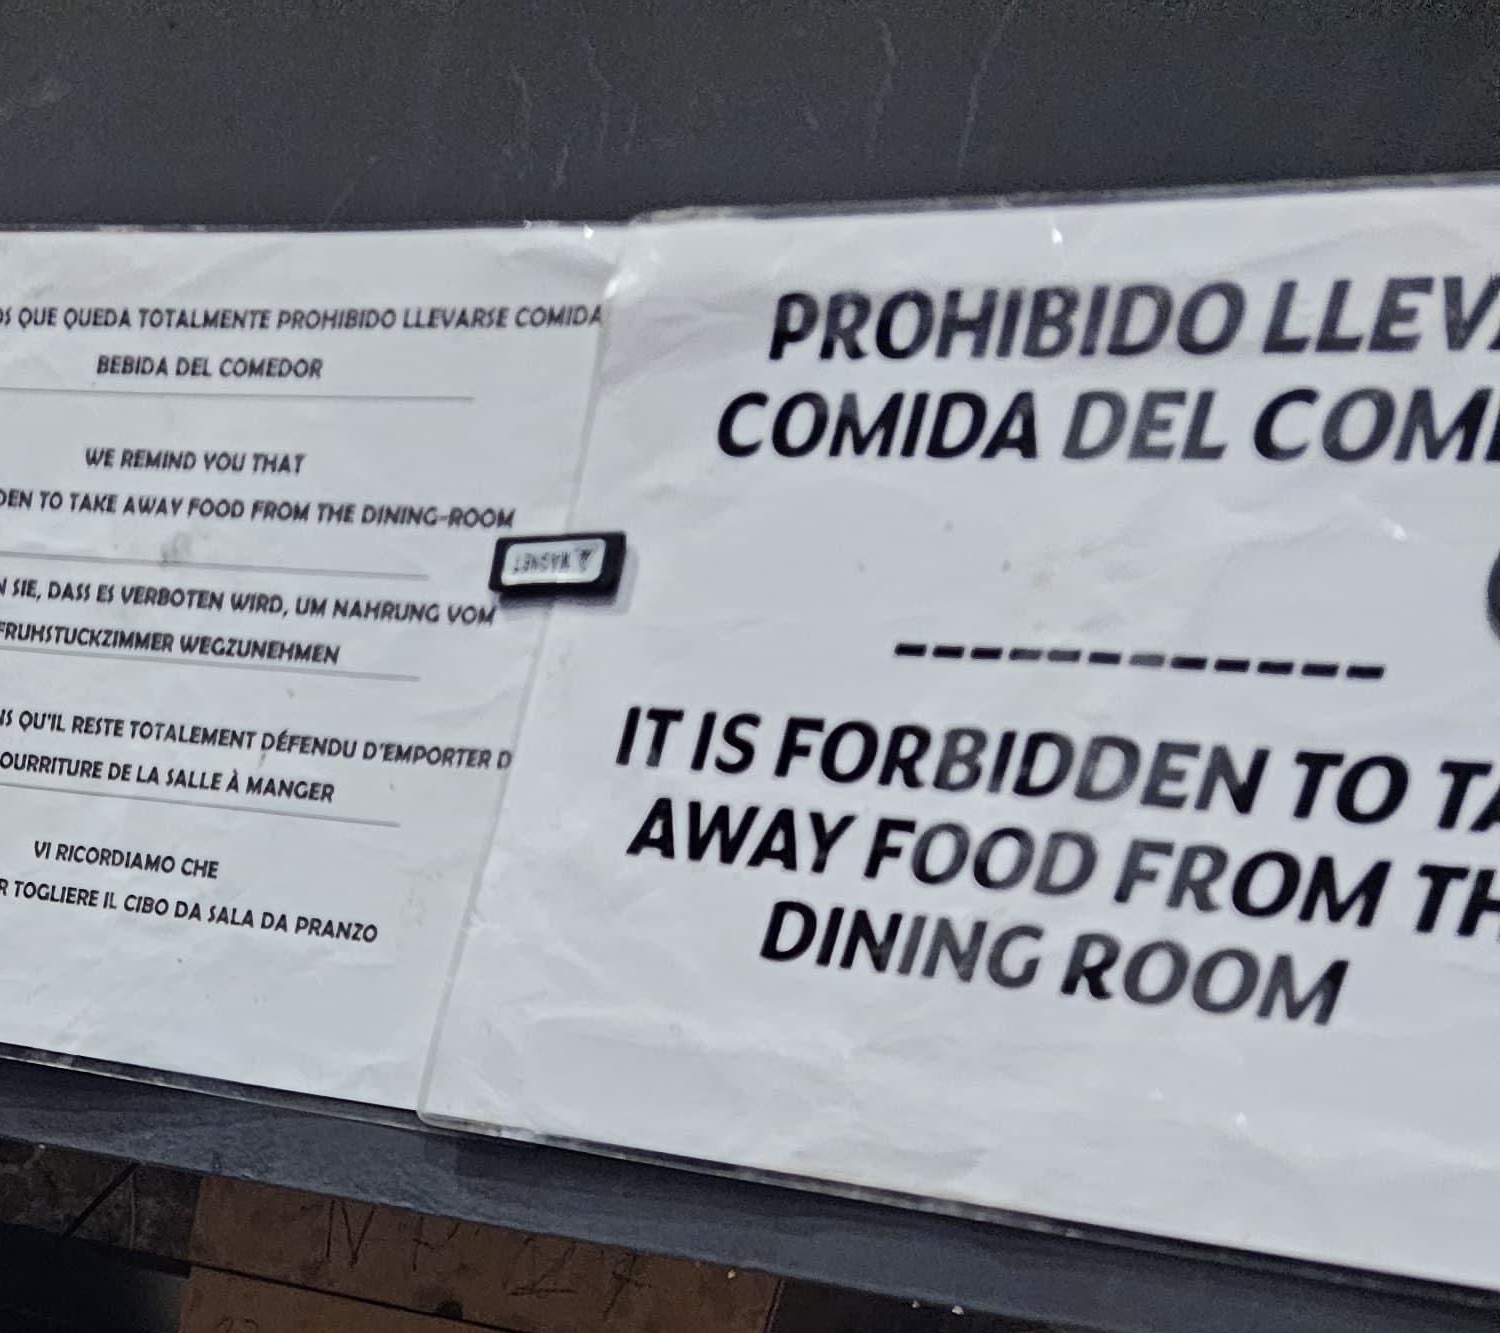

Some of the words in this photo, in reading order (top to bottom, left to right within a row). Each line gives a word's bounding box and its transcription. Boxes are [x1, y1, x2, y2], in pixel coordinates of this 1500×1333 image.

[17, 305, 59, 331] QUE
[62, 306, 133, 331] QUEDA
[137, 307, 273, 331] TOTALMENTE
[275, 307, 397, 331] PROHIBIDO
[402, 306, 511, 330] LLEVARSE
[514, 303, 603, 329] COMIDA
[768, 280, 1247, 362] PROHIBIDO
[1261, 273, 1500, 355] LLEV
[95, 354, 169, 377] BEBIDA
[174, 355, 213, 379] DEL
[218, 356, 324, 380] COMEDOR
[717, 390, 1038, 461] COMIDA
[1062, 388, 1228, 461] DEL
[84, 447, 117, 469] WE
[119, 447, 198, 471] REMIND
[203, 450, 248, 473] YOU
[251, 451, 307, 475] THAT
[39, 489, 64, 513] TO
[69, 491, 119, 515] TAKE
[121, 495, 185, 518] AWAY
[186, 496, 246, 520] FOOD
[249, 499, 312, 523] FROM
[316, 501, 357, 525] THE
[360, 503, 517, 530] DINING-ROOM
[11, 577, 42, 603] SIE,
[47, 579, 92, 604] DASS
[95, 583, 116, 605] ES
[120, 584, 226, 613] VERBOTEN
[229, 591, 289, 620] WIRD,
[294, 595, 329, 618] UM
[331, 597, 441, 625] NAHRUNG
[446, 604, 497, 627] VOM
[179, 633, 341, 666] WEGZUNEHMEN
[18, 709, 67, 734] QU'IL
[70, 714, 126, 739] RESTE
[129, 719, 258, 751] TOTALEMENT
[259, 728, 359, 762] DÉFENDU
[361, 740, 493, 770] D'EMPORTER
[107, 761, 133, 783] DE
[135, 764, 160, 787] LA
[164, 767, 224, 792] SALLE
[244, 775, 335, 804] MANGER
[616, 705, 685, 768] IT
[690, 710, 762, 776] IS
[773, 716, 1271, 816] FORBIDDEN
[1292, 750, 1411, 826] TO
[33, 839, 53, 861] VI
[54, 842, 176, 875] RICORDIAMO
[180, 857, 220, 880] CHE
[625, 797, 858, 874] AWAY
[862, 816, 1099, 897] FOOD
[1113, 838, 1393, 929] FROM
[13, 879, 101, 908] TOGLIERE
[102, 890, 118, 911] IL
[123, 893, 170, 917] CIBO
[173, 899, 202, 923] DA
[206, 904, 255, 929] SALA
[259, 911, 289, 934] DA
[293, 914, 379, 944] PRANZO
[759, 900, 1045, 990] DINING
[1060, 932, 1350, 1026] ROOM
